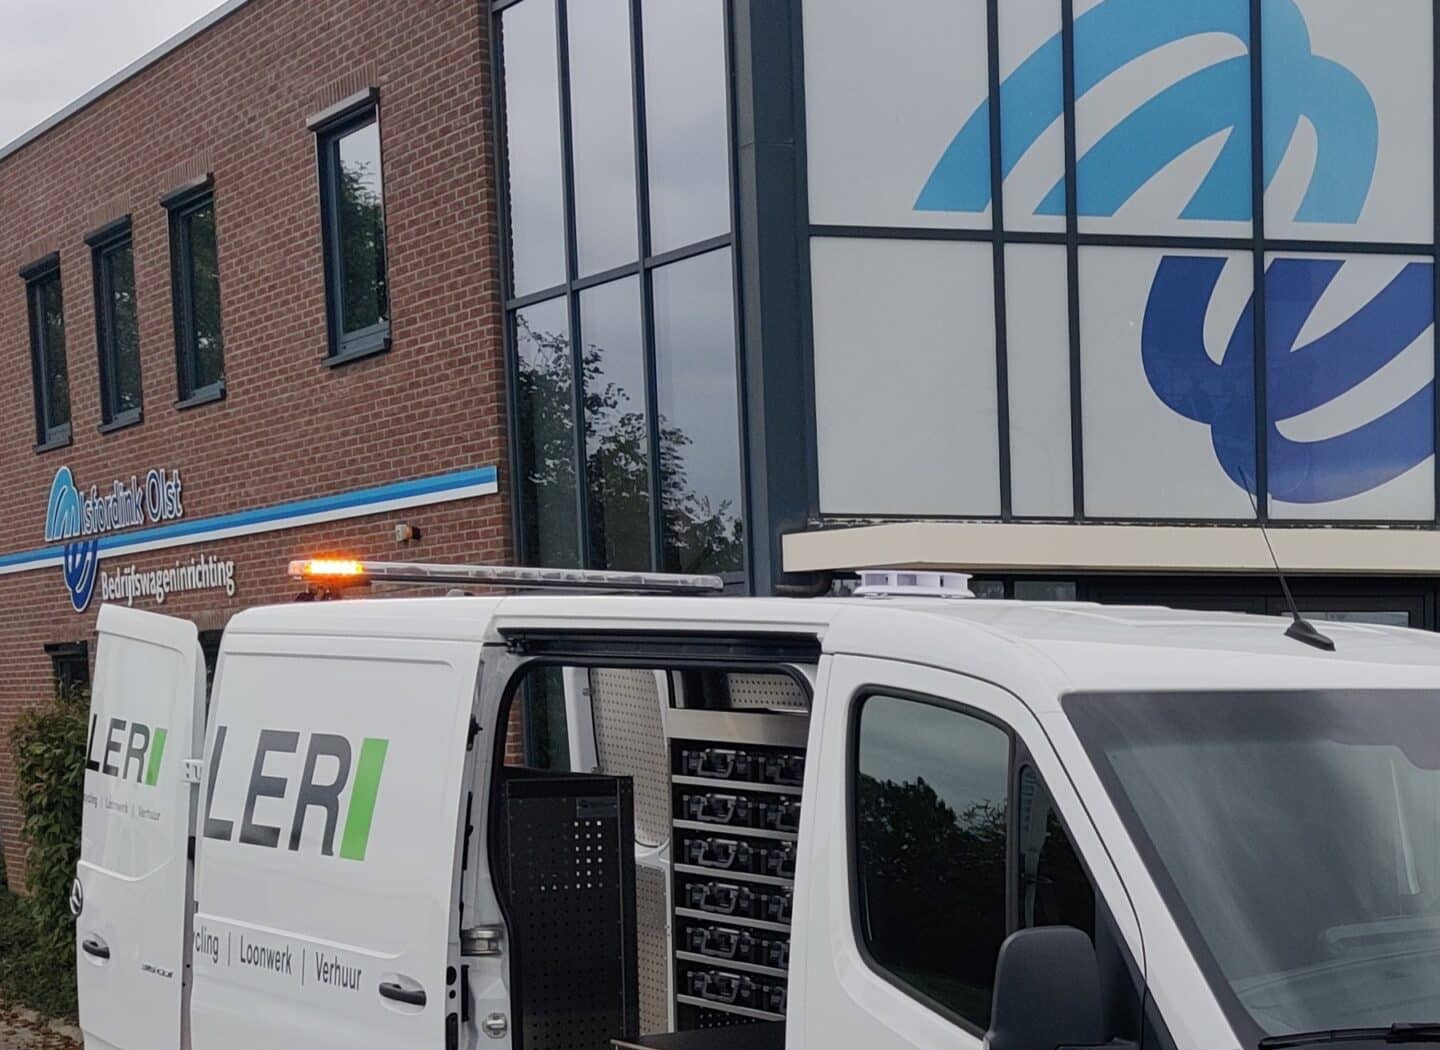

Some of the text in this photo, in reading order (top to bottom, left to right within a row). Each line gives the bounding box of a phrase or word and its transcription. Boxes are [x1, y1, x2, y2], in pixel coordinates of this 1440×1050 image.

[146, 468, 183, 522] Olst
[101, 554, 236, 607] Bedrijfswageninrichting
[240, 935, 292, 975] Loonwerk
[315, 951, 362, 991] Verhuur
